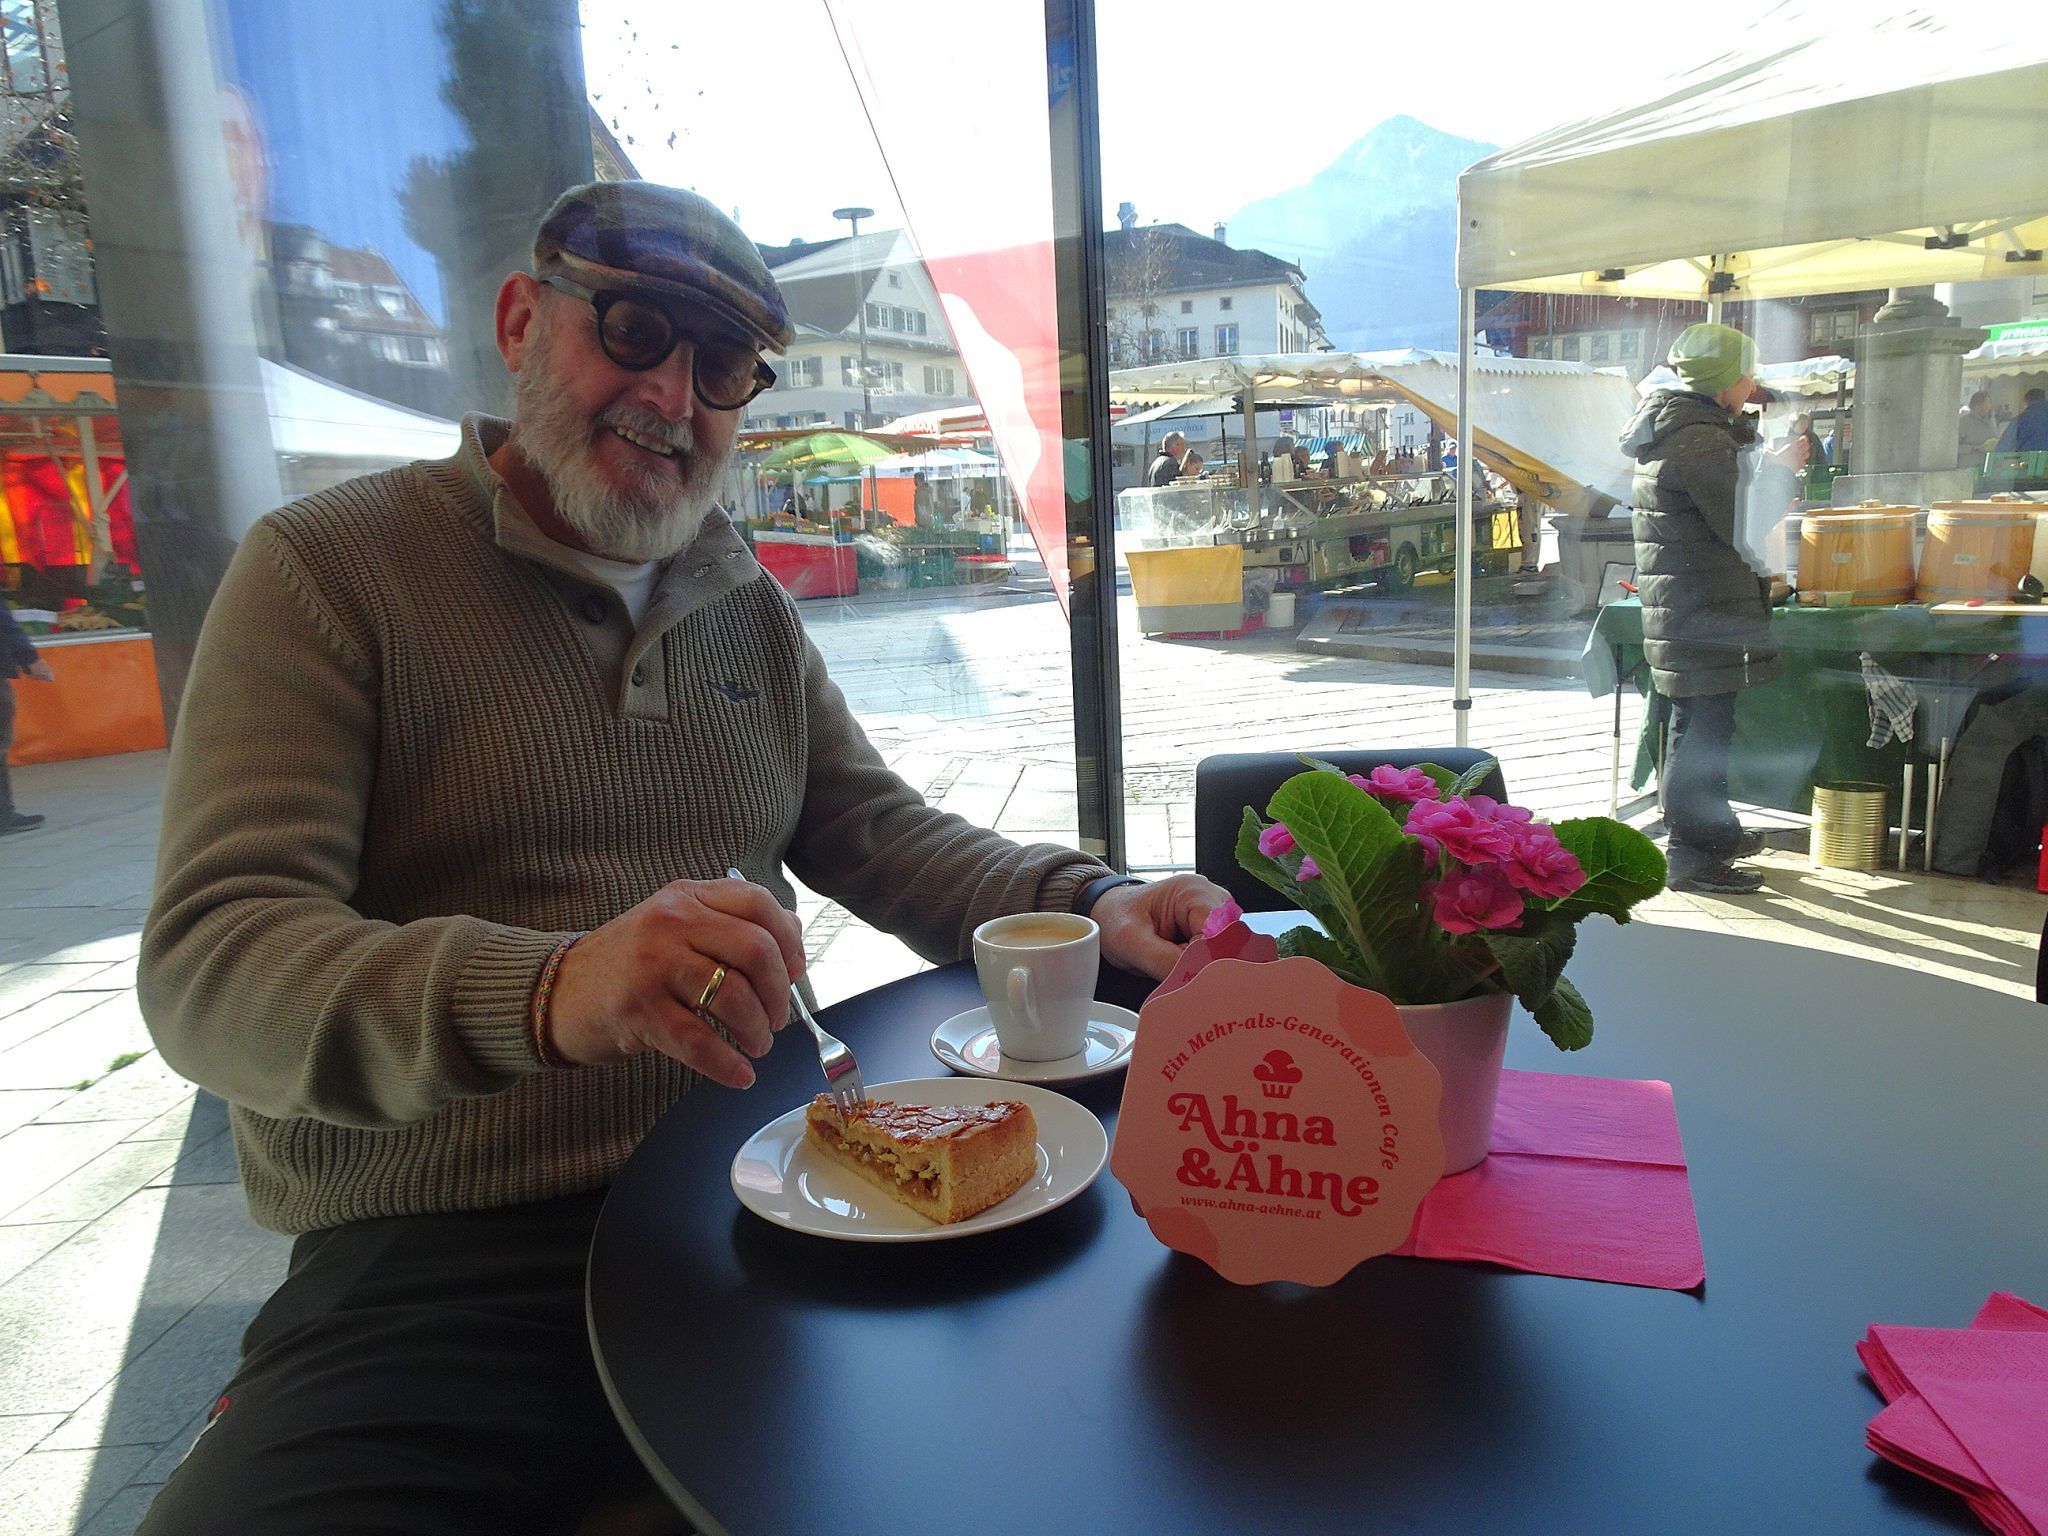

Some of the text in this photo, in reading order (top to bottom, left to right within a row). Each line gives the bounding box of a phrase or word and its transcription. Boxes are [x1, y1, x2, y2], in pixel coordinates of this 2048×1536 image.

[1162, 1013, 1400, 1170] Ein Mehr-als-Generationen Cafe
[1167, 1093, 1337, 1153] Ahna
[1181, 1196, 1322, 1219] www.ahna-aehne.at
